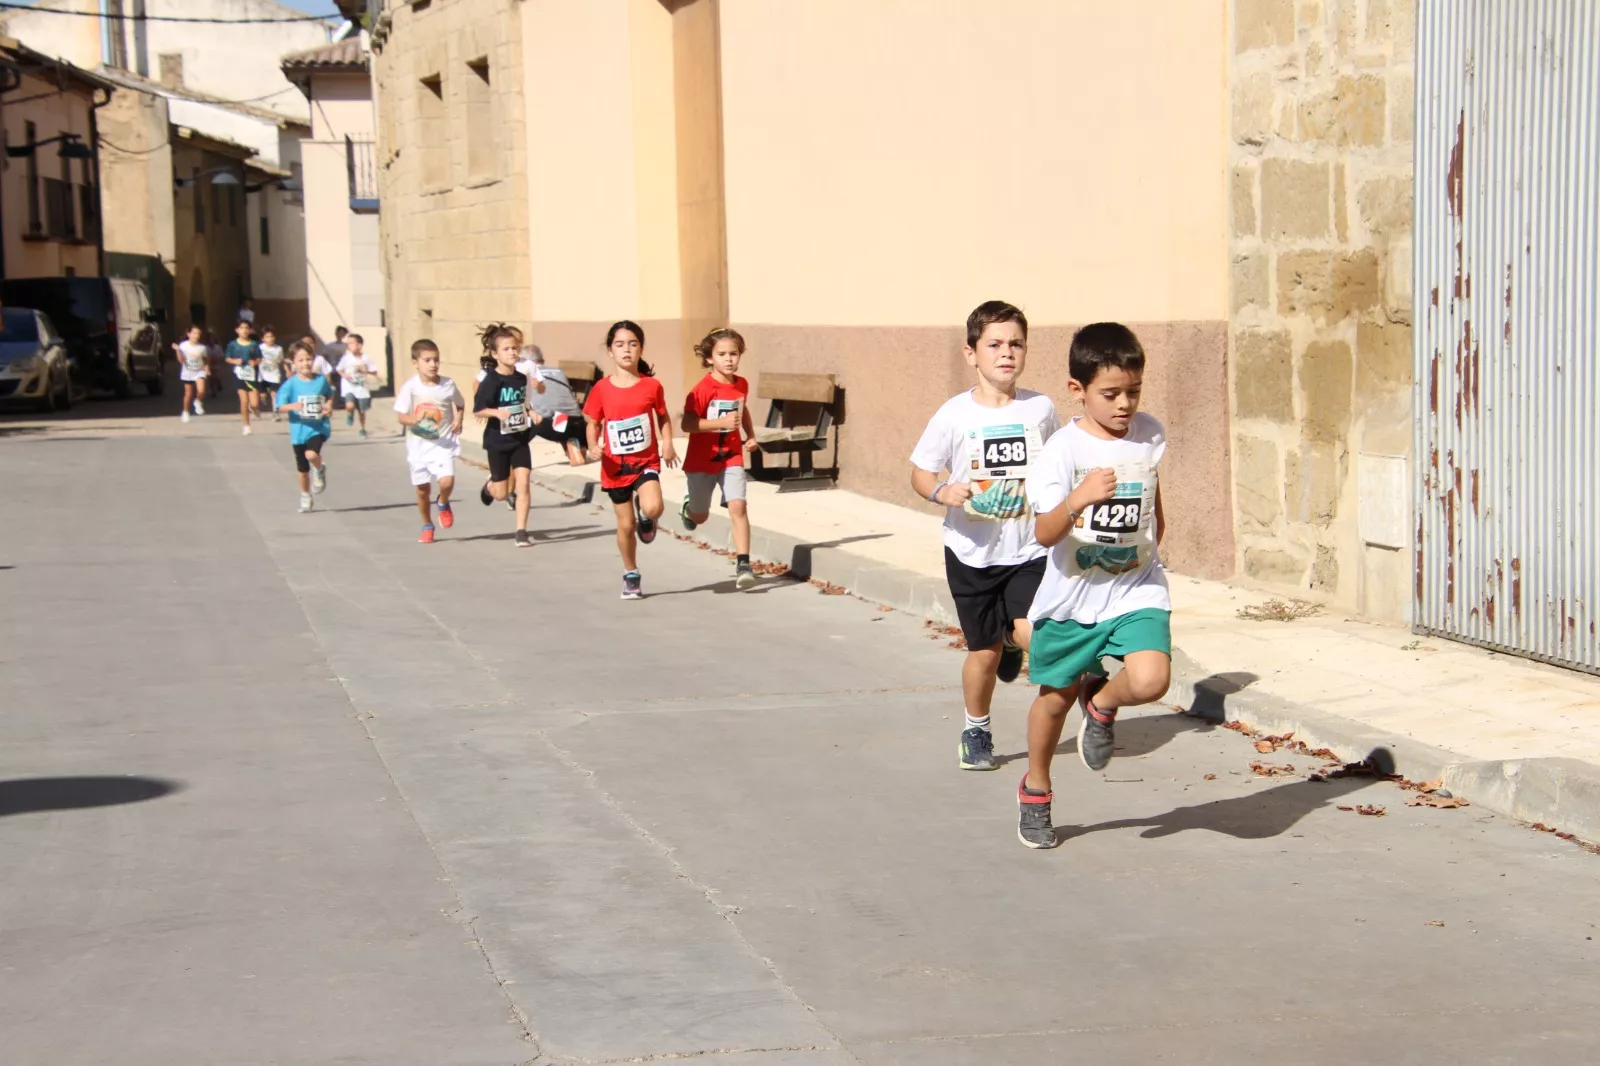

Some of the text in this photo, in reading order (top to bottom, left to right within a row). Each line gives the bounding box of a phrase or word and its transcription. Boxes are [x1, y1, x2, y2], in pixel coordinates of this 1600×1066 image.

[619, 428, 644, 444] 442
[986, 441, 1025, 463] 438
[1094, 504, 1139, 528] 428
